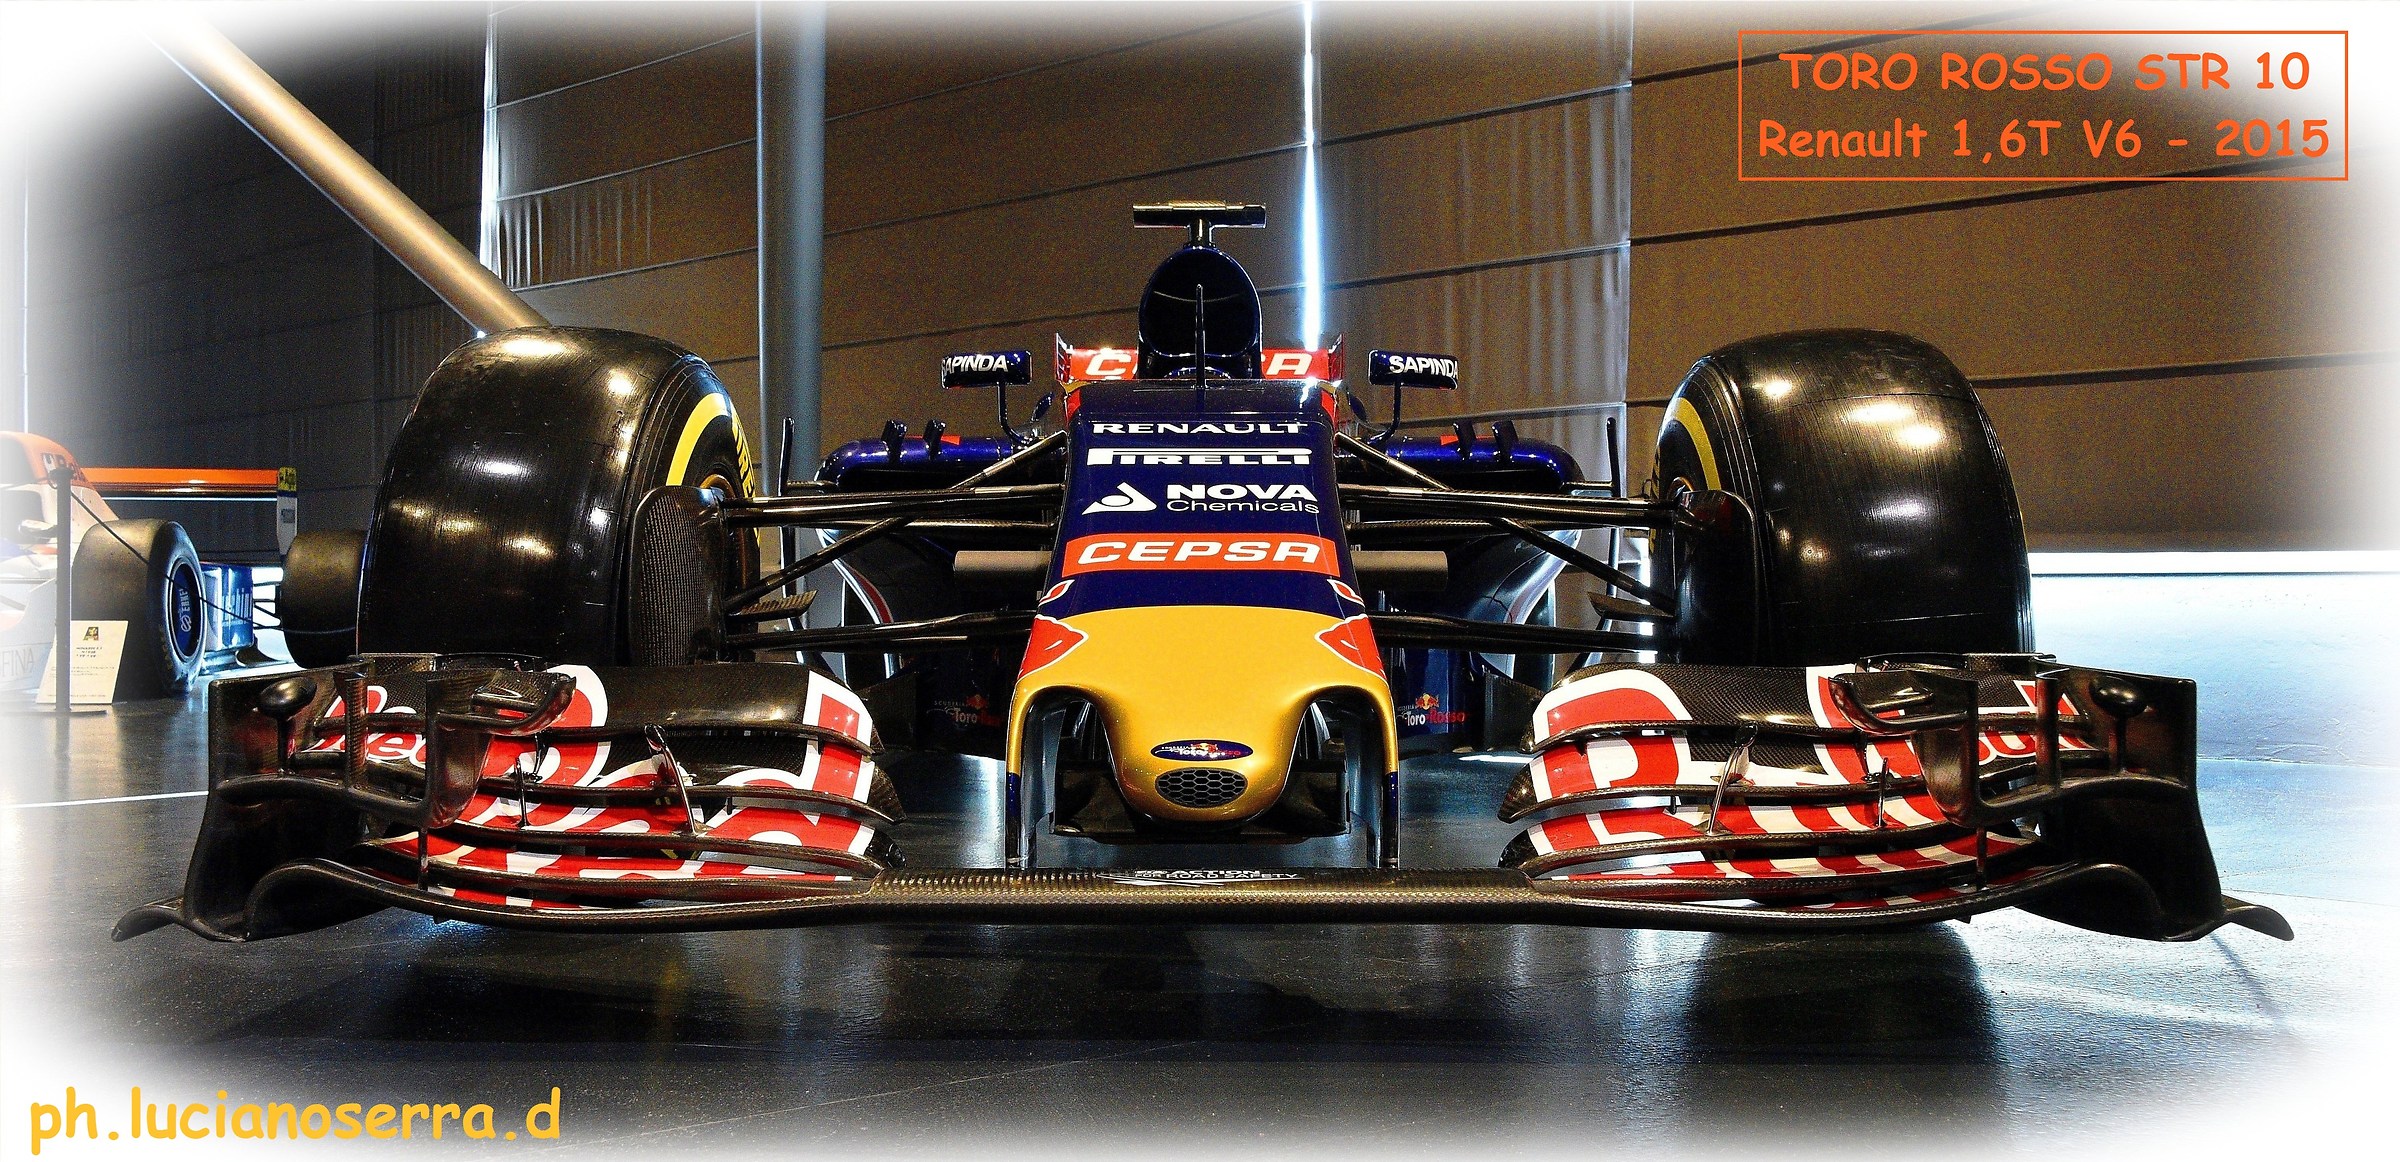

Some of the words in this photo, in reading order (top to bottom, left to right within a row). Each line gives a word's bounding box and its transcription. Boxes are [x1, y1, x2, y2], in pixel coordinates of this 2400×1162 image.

[1389, 355, 1459, 379] SAPINDA
[1093, 423, 1308, 434] RENAULT
[1087, 447, 1313, 466] PIRELLI
[1166, 484, 1318, 500] NOVA
[1166, 499, 1320, 514] Chemicals
[1077, 540, 1322, 564] CEPSA
[953, 707, 977, 723] Toro
[1407, 711, 1426, 726] Toro
